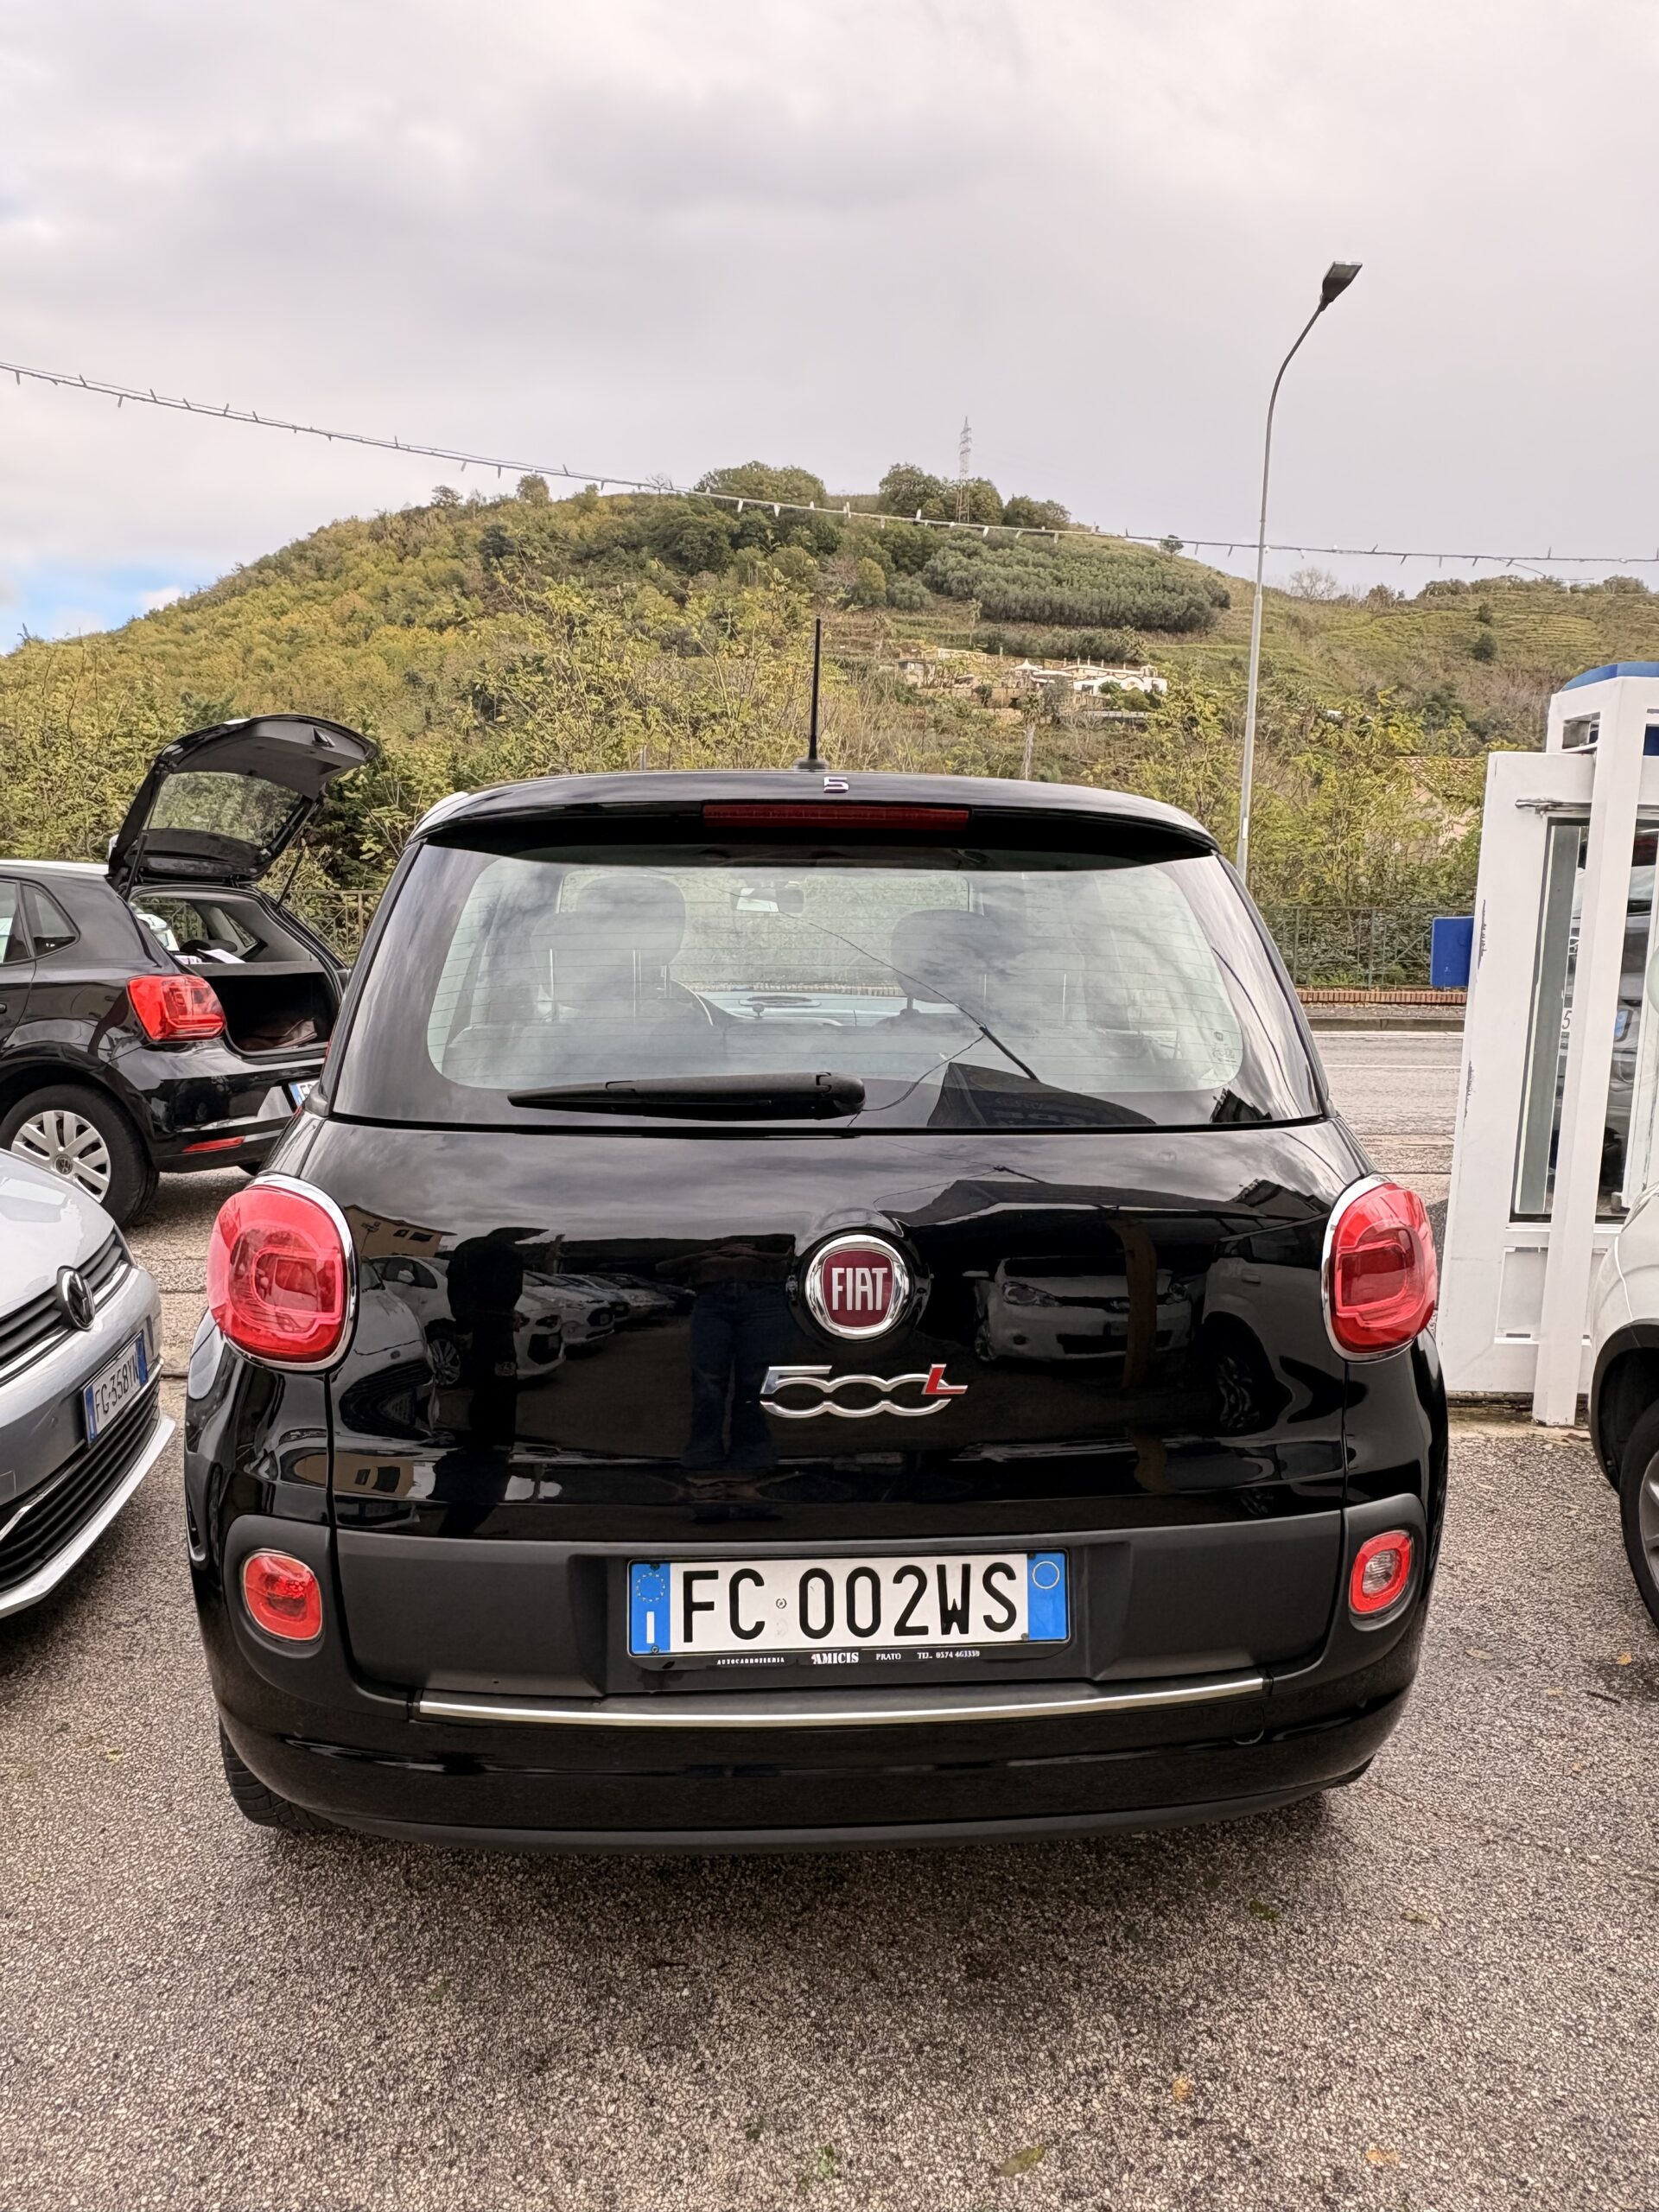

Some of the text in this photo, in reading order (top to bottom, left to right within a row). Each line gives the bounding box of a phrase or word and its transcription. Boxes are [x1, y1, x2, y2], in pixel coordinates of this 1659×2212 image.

[823, 777, 849, 793] 5
[831, 1268, 888, 1311] FIAT
[760, 1363, 969, 1419] 500L
[683, 1561, 1017, 1643] FC 002WS
